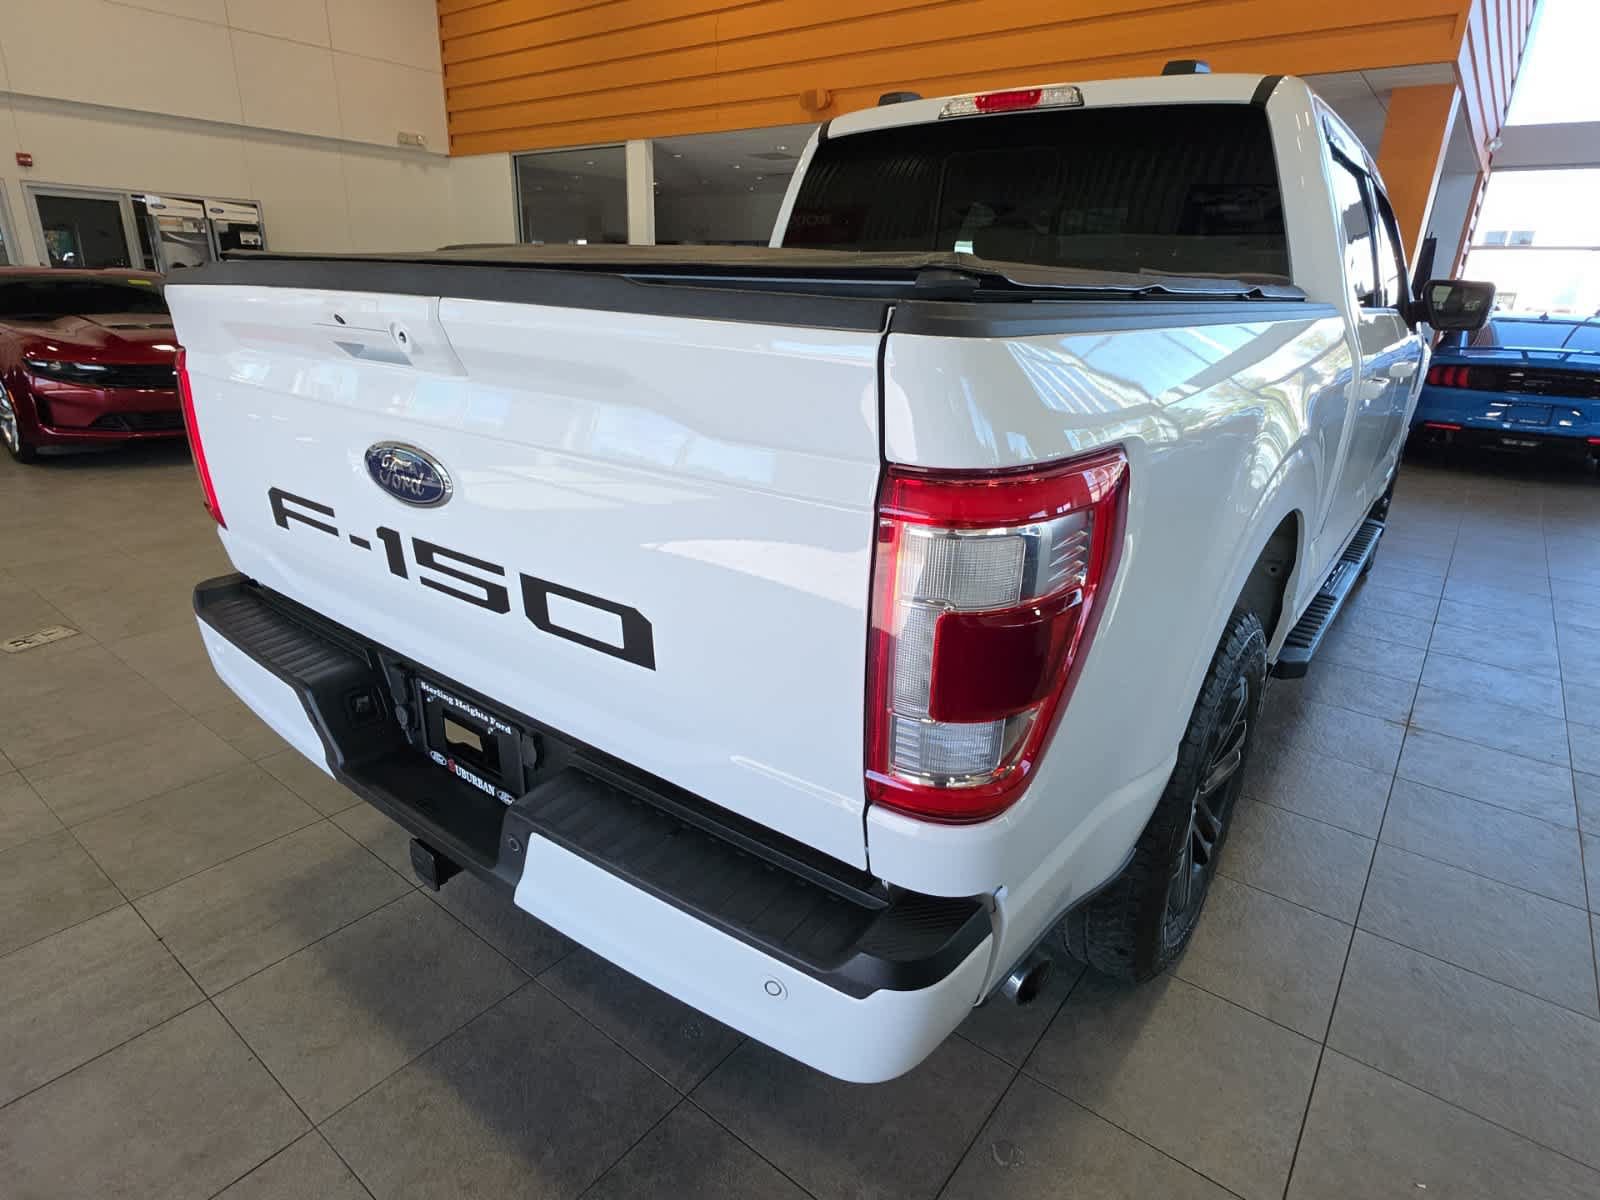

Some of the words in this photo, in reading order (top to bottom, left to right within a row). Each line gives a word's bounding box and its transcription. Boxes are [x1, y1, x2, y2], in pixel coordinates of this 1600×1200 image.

[379, 454, 425, 496] Ford
[268, 486, 656, 671] F-150
[421, 681, 455, 706] Sterling
[455, 698, 489, 722] Heights
[488, 715, 512, 735] Ford
[447, 757, 496, 797] SUBURBAN
